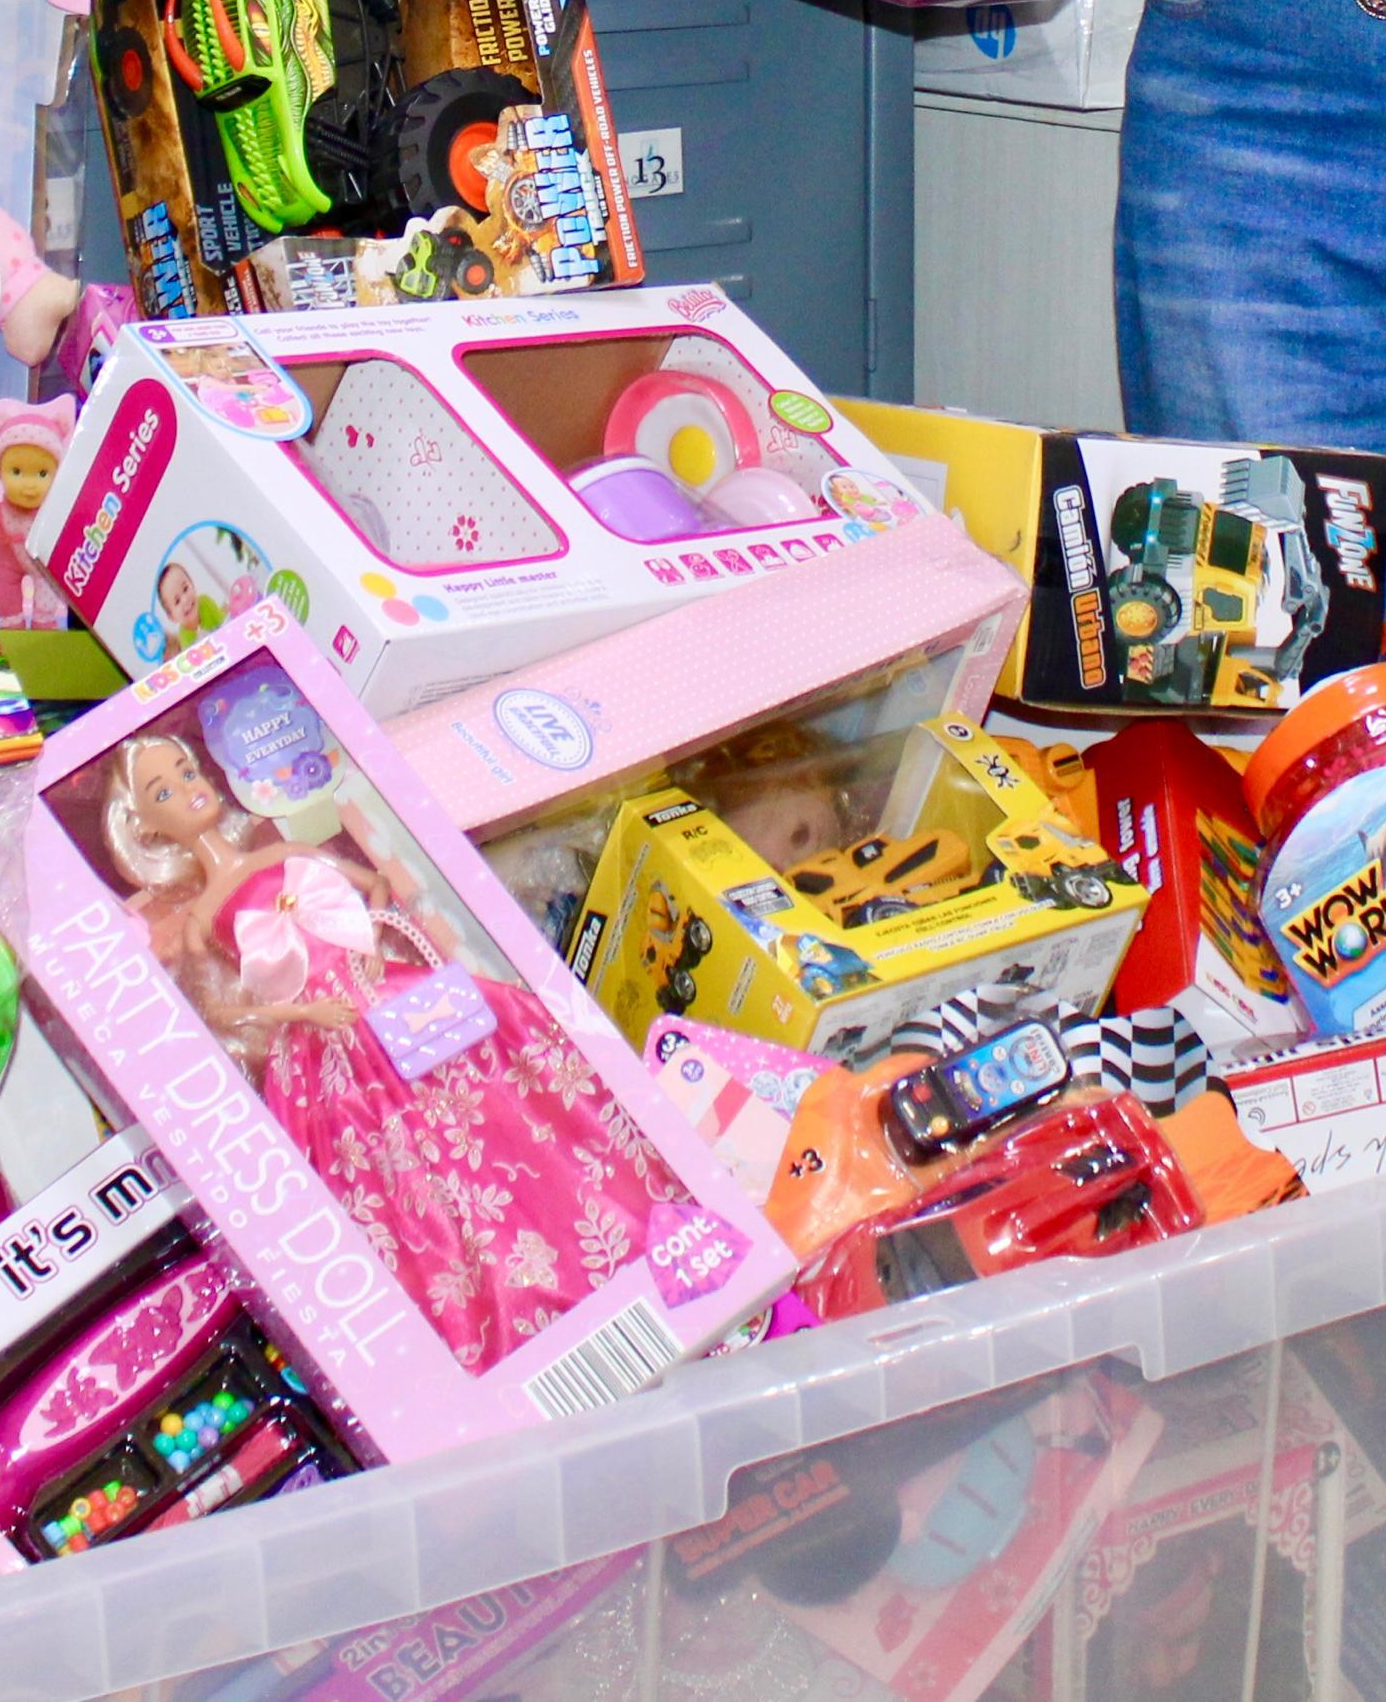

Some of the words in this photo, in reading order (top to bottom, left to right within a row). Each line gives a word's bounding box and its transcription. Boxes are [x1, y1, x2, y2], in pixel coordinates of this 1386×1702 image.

[582, 49, 603, 104] VEHICLES
[595, 105, 617, 167] OFF-ROAD
[525, 113, 602, 282] POWER
[608, 167, 626, 212] POWER
[634, 155, 666, 194] 13
[196, 203, 223, 262] SPORT
[217, 182, 241, 252] VEHICLE
[618, 213, 638, 268] FRICTION
[143, 200, 197, 318] WER
[461, 312, 527, 327] Kitchen
[527, 308, 580, 323] Series
[64, 492, 122, 597] Kitchen
[112, 408, 159, 493] Series
[443, 580, 484, 595] Happy
[484, 576, 516, 589] Little
[518, 571, 558, 584] master
[243, 603, 289, 644] +3
[132, 663, 182, 703] KIDS
[240, 712, 292, 745] HAPPY
[245, 727, 307, 765] EVERYDAY
[524, 705, 575, 741] LIVE
[649, 802, 698, 824] Tonka
[682, 826, 708, 840] R/C
[1275, 882, 1302, 909] 3+
[1288, 866, 1378, 946] WOW
[571, 911, 604, 985] Tonka
[27, 934, 125, 1067] MUÑECA
[138, 1084, 248, 1231] VESTIDO
[256, 1248, 347, 1368] FIESTA
[52, 900, 199, 1056] PARTY
[165, 1055, 309, 1217] DRESS
[278, 1207, 408, 1368] DOLL
[1294, 1130, 1352, 1178] spe
[788, 1148, 824, 1178] +3
[651, 1215, 718, 1267] cont.
[677, 1267, 694, 1288] 1
[690, 1238, 734, 1276] set
